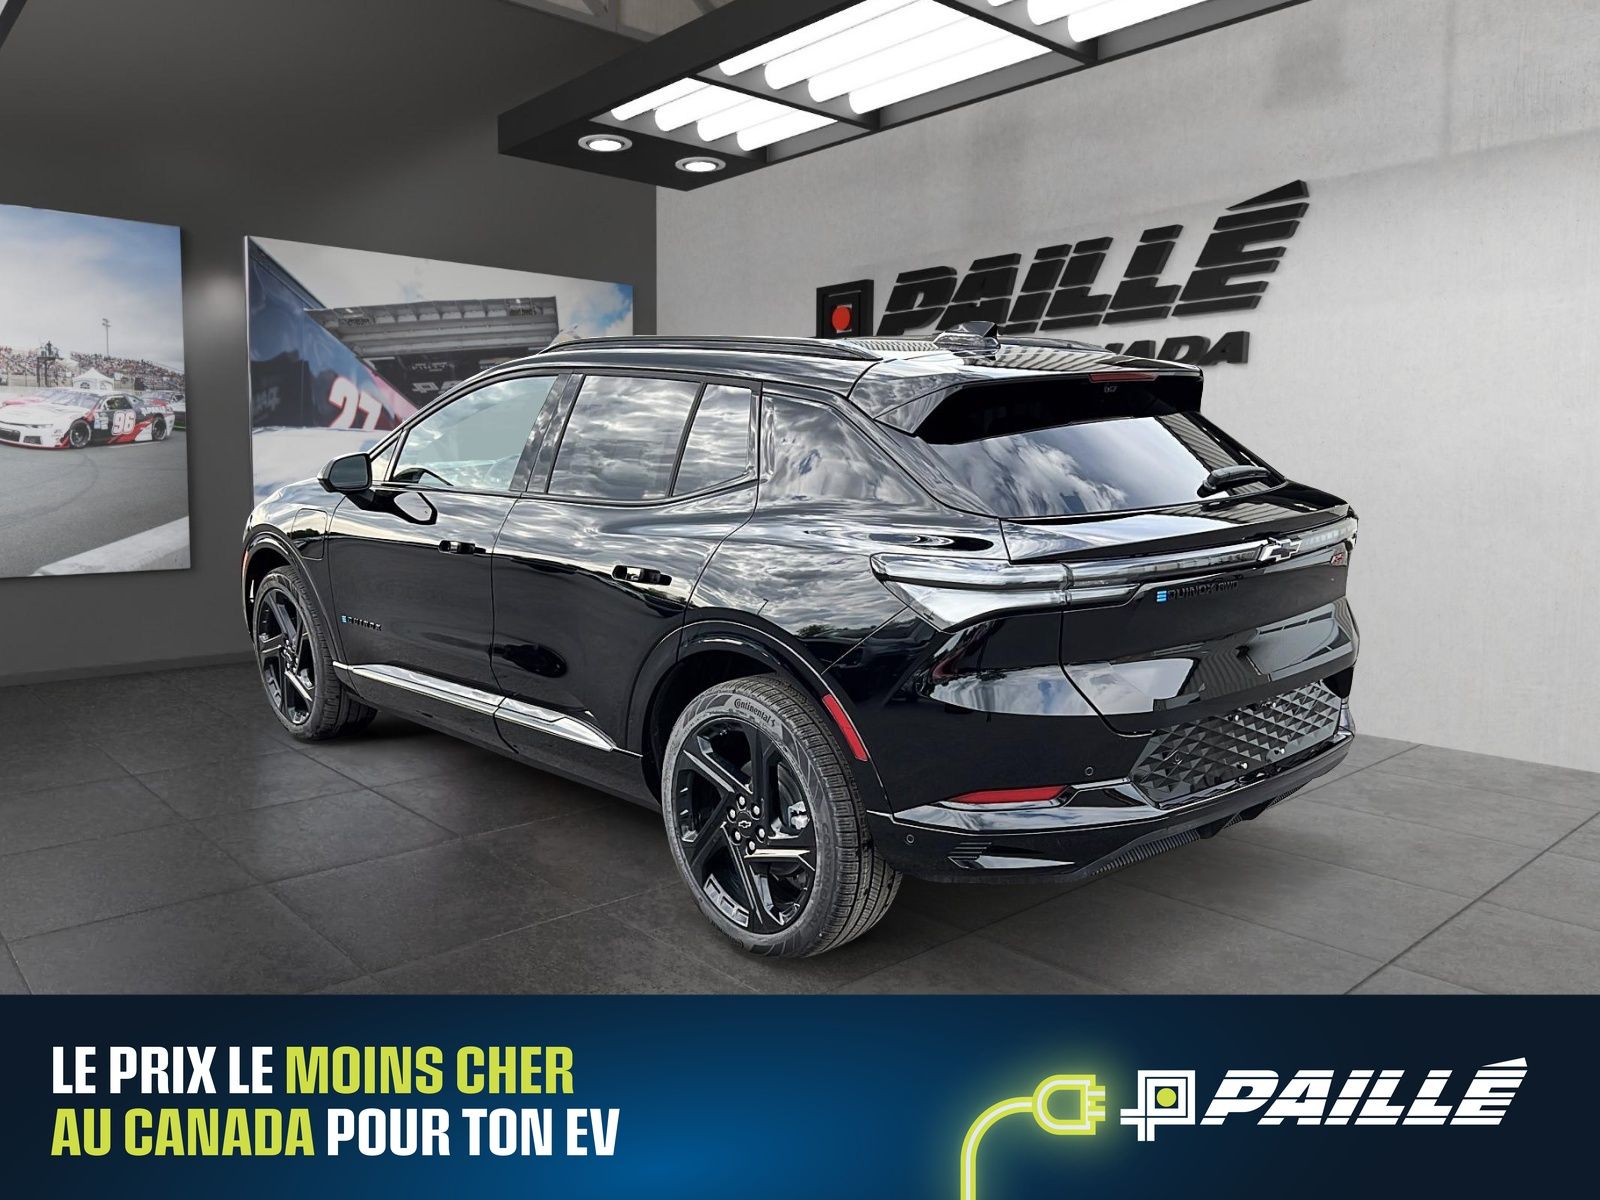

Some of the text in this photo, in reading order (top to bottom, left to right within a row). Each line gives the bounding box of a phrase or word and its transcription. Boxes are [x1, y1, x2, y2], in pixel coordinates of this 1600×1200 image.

[876, 179, 1310, 336] PAILLÉ
[111, 408, 137, 436] 96
[328, 375, 383, 432] 27
[734, 698, 771, 724] Continental
